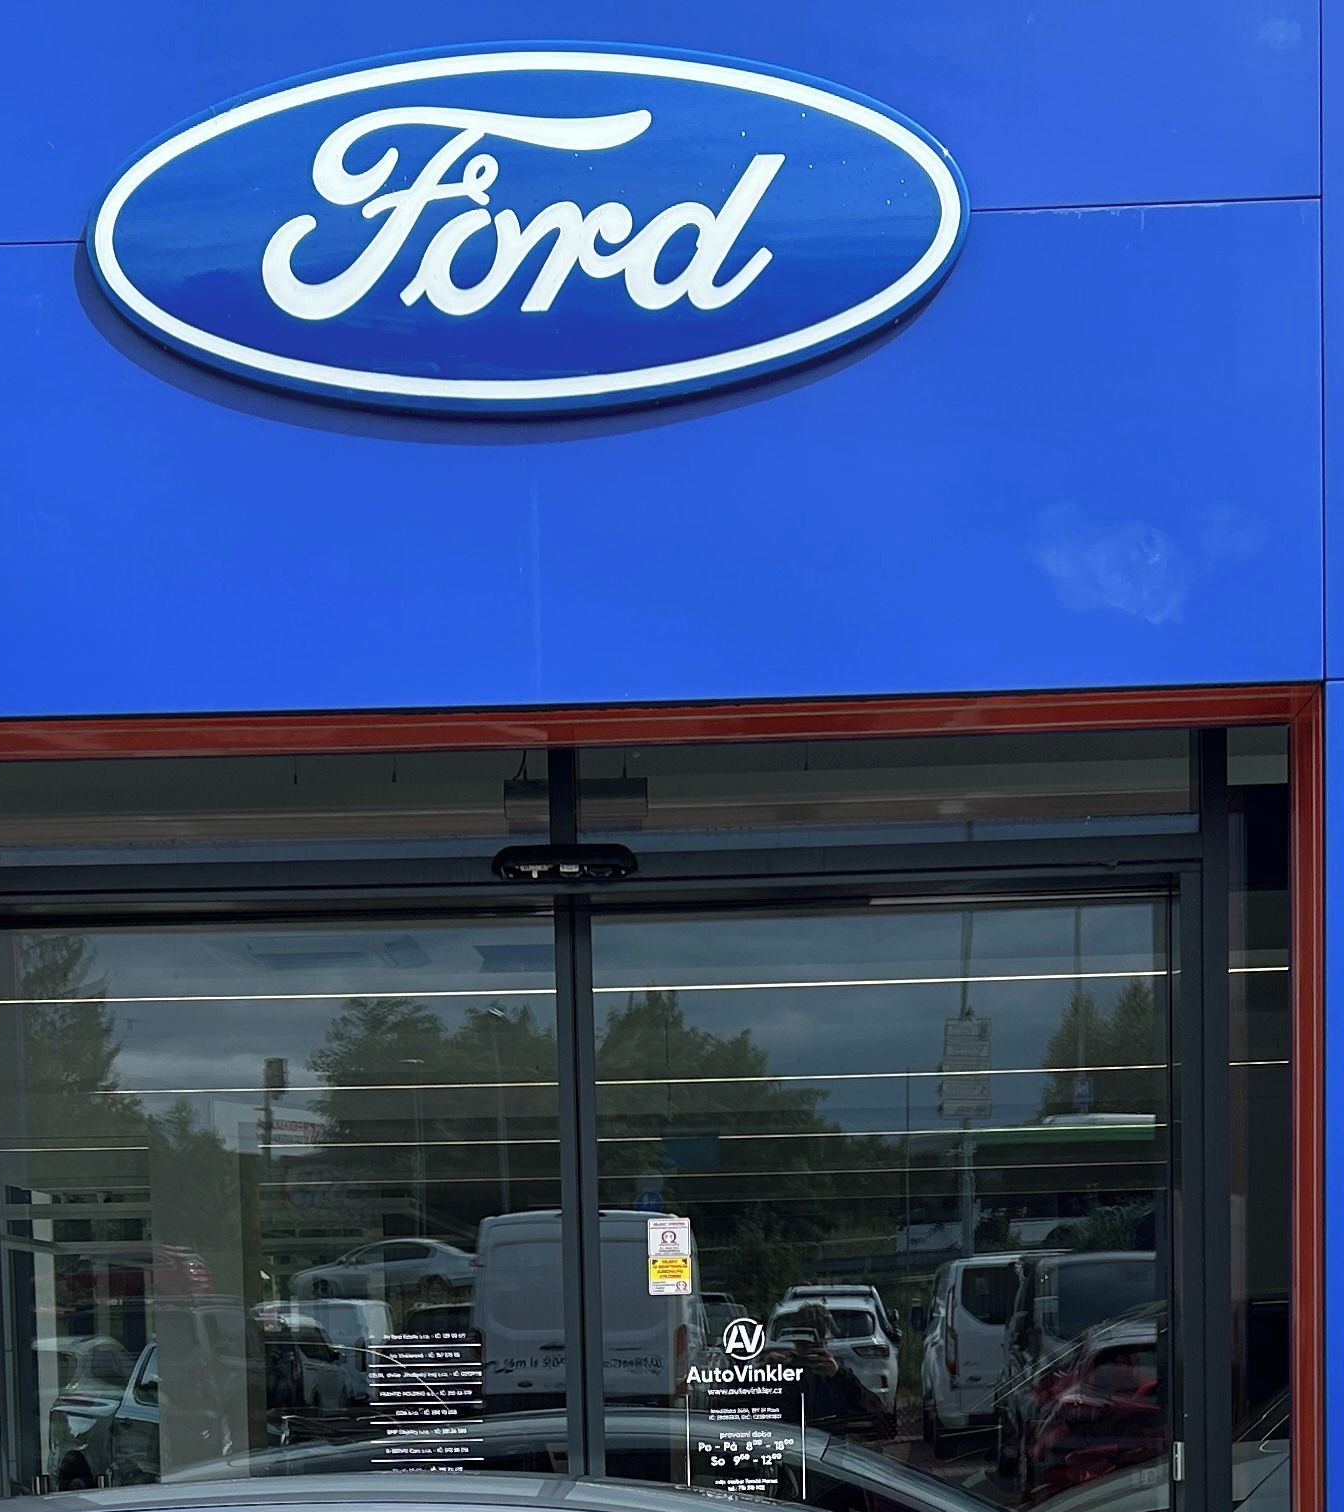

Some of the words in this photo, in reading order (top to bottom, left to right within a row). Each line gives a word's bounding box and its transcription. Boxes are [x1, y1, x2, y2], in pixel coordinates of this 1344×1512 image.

[262, 106, 786, 320] Ford
[725, 1324, 763, 1354] AV
[686, 1364, 803, 1383] AutoVinkler
[698, 1441, 713, 1452] Po
[723, 1441, 738, 1452] Pá
[710, 1456, 726, 1467] So
